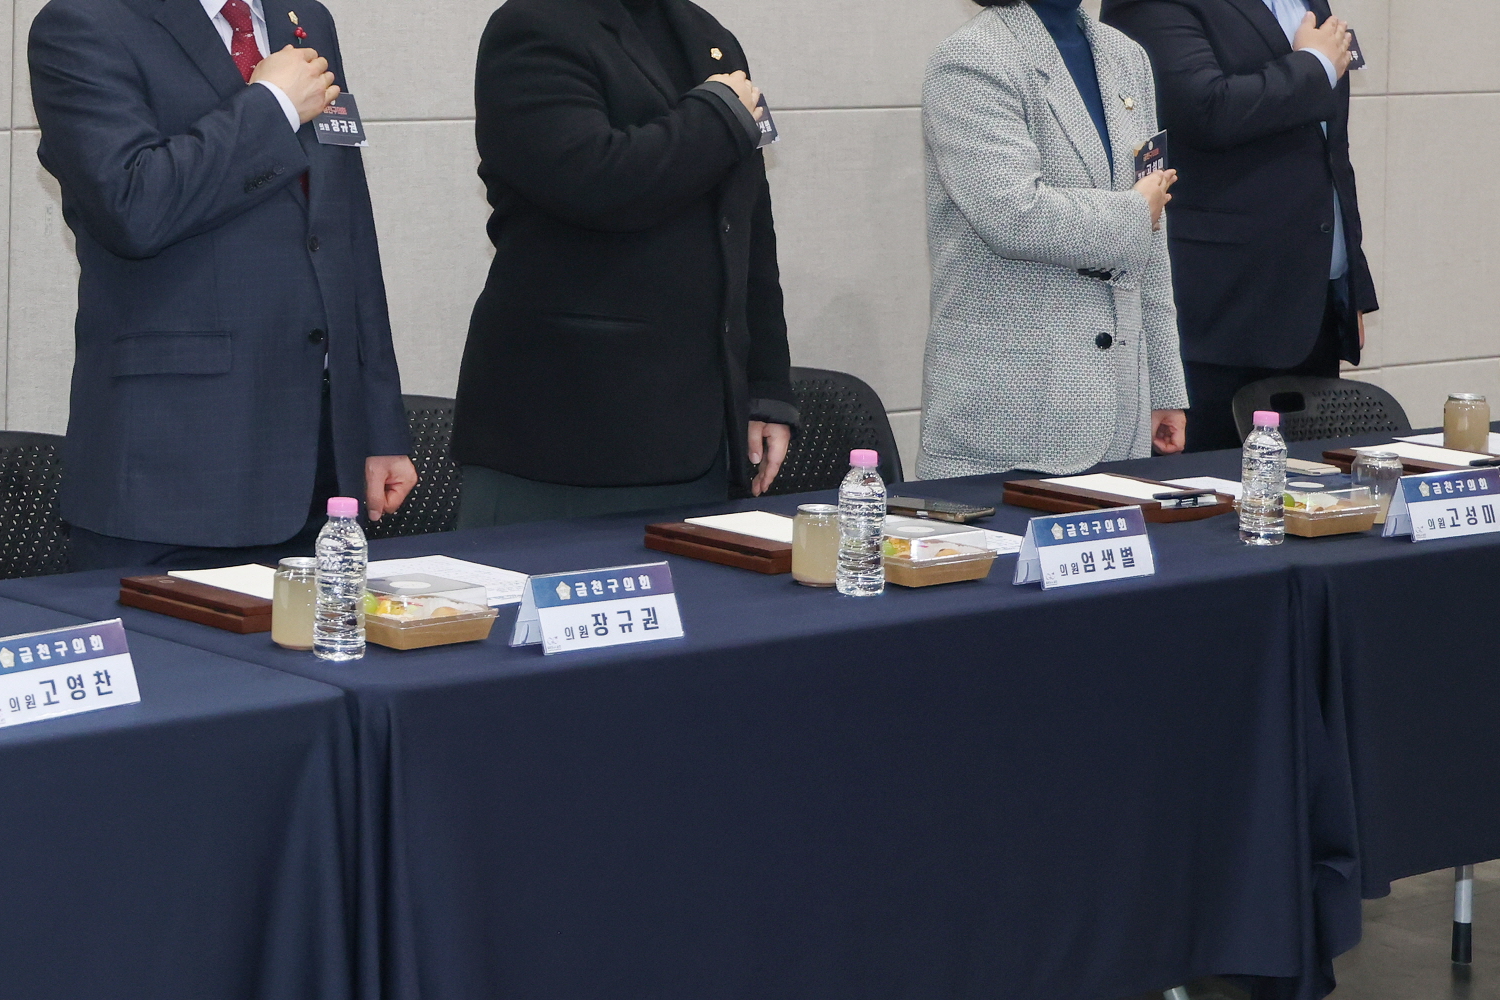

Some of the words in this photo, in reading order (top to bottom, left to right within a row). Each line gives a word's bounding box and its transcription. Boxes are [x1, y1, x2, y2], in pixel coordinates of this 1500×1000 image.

[1432, 478, 1488, 495] 금천구의회
[1066, 517, 1128, 537] 금천구의회
[1428, 517, 1446, 530] 의원
[1446, 504, 1496, 528] 고성미
[1060, 562, 1080, 576] 의원
[1081, 546, 1135, 573] 엄샛별
[574, 574, 651, 597] 금천구의회
[564, 625, 589, 640] 의원
[591, 607, 659, 636] 장규권
[18, 634, 104, 663] 금천구의회
[9, 693, 37, 713] 의원
[39, 670, 113, 706] 고영찬
